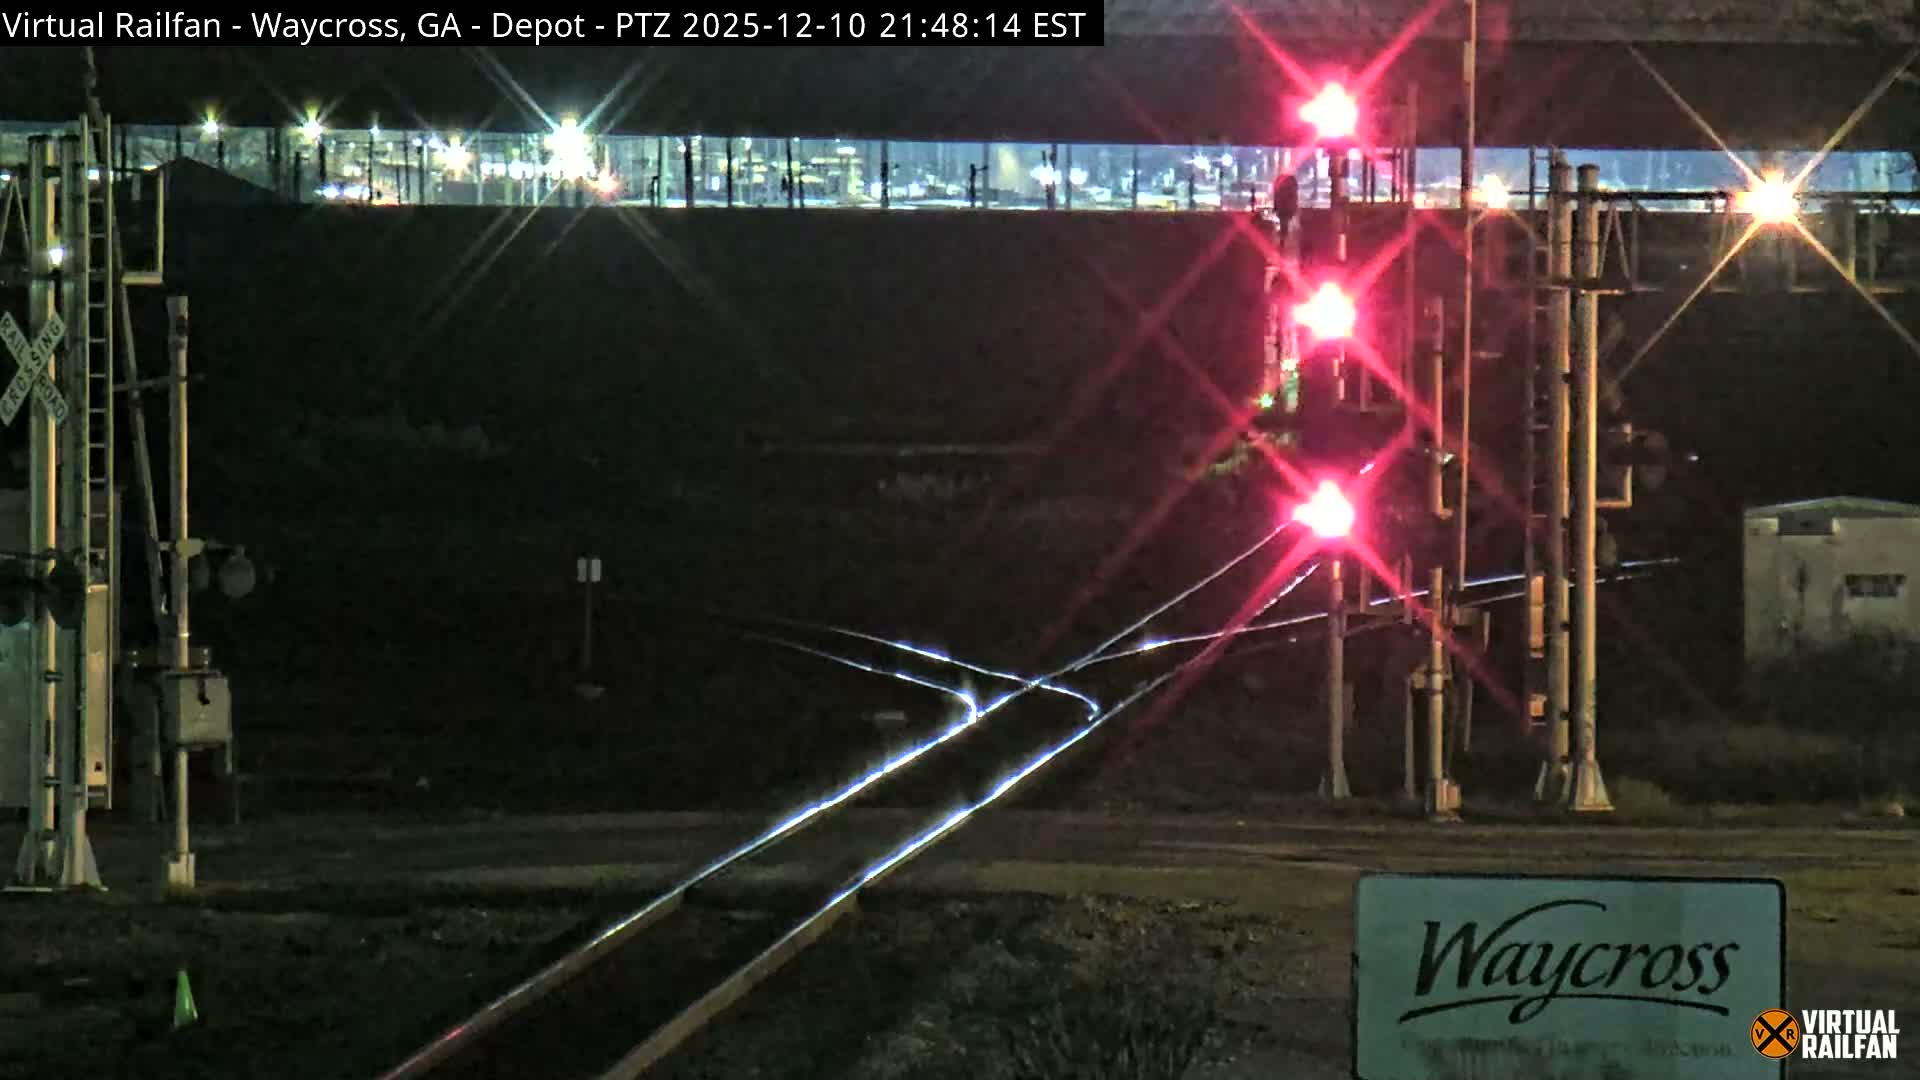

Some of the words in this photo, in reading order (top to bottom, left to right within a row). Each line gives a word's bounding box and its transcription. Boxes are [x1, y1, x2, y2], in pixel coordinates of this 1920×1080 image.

[1, 320, 62, 416] CROSSING
[1, 318, 25, 362] RAIL
[39, 373, 65, 422] ROAD
[1412, 899, 1740, 1025] Waycross
